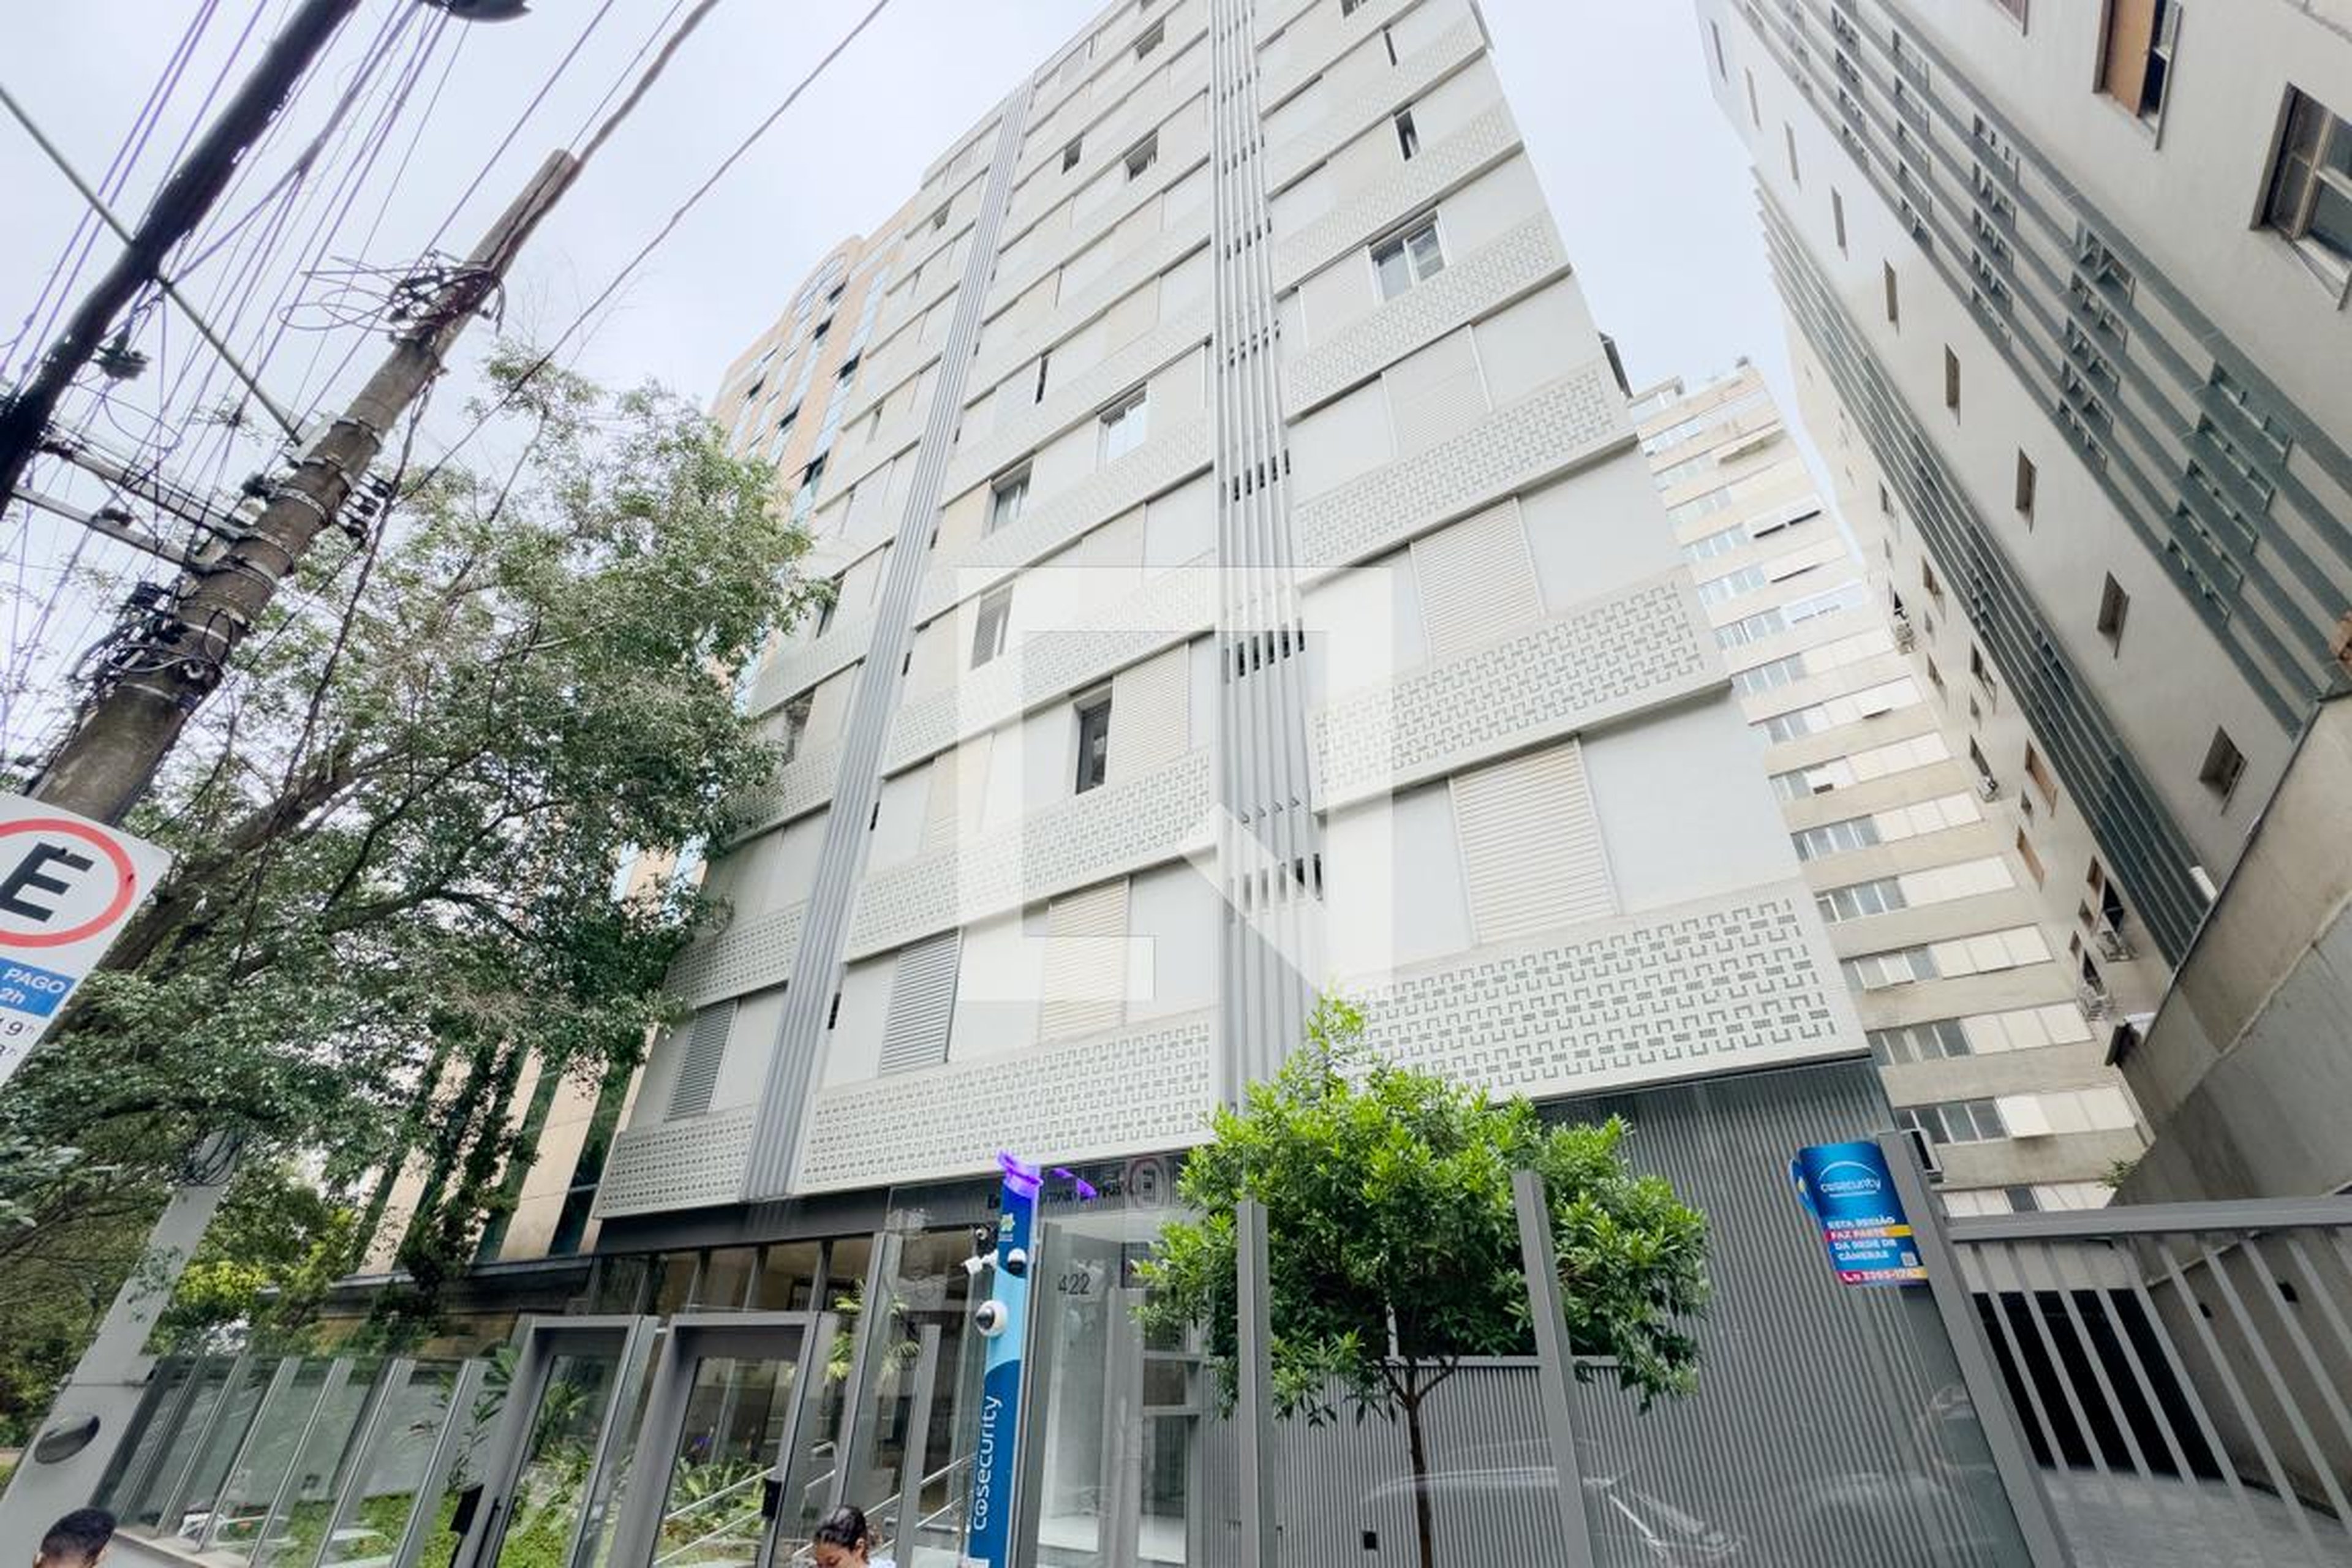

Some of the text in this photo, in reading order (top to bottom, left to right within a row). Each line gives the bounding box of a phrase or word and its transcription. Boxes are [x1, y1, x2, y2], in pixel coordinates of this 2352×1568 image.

[0, 842, 94, 922] E
[3, 968, 66, 993] PAGO
[1831, 1230, 1852, 1240] FAZ
[1834, 1241, 1850, 1250] DA
[1058, 1273, 1091, 1295] 422
[973, 1395, 1003, 1530] cosecurity
